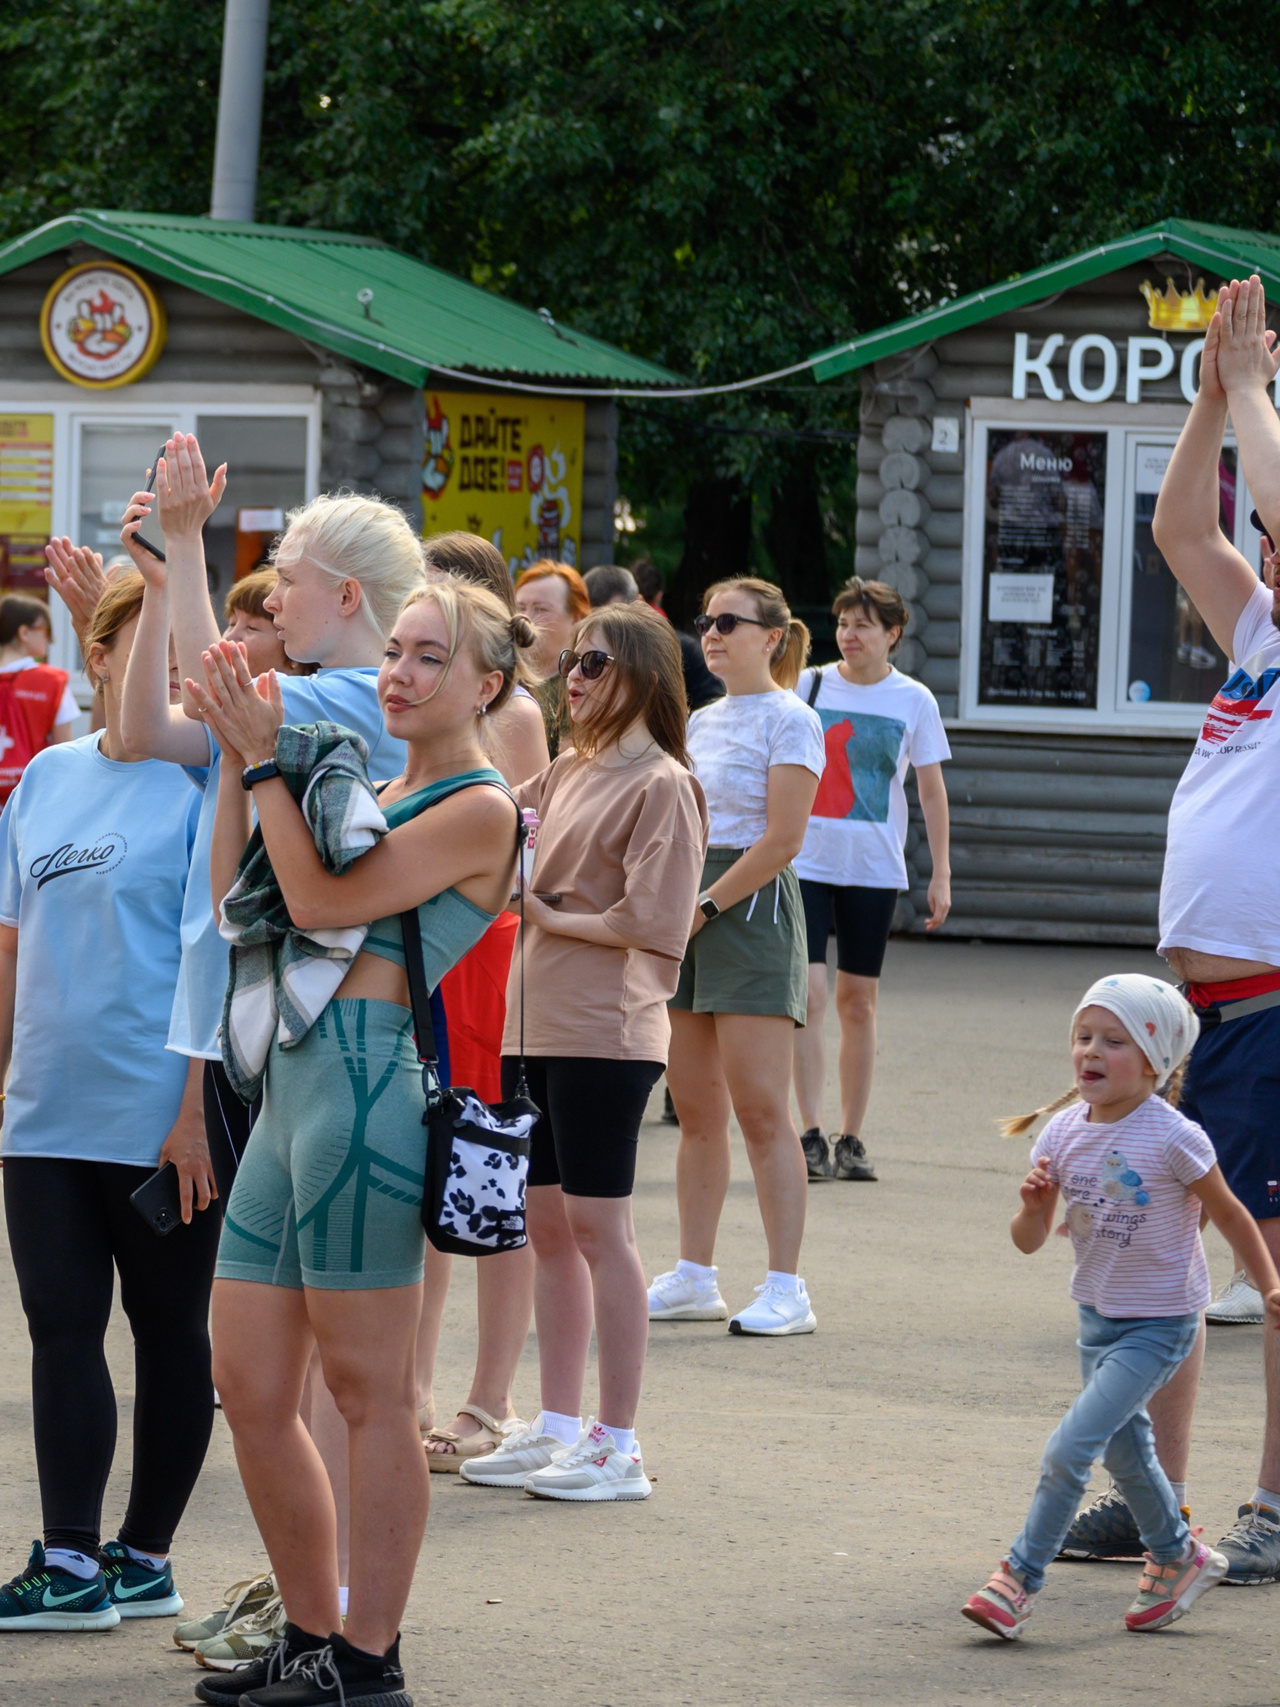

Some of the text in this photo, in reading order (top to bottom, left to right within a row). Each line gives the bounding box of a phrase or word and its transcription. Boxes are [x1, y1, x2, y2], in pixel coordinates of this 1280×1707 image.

[459, 407, 522, 454] ДАЙТЕ
[1020, 452, 1073, 472] Меню
[459, 456, 505, 492] ДВЕ!
[29, 842, 116, 880] Легко
[1071, 1173, 1098, 1187] one
[1102, 1211, 1147, 1232] wings
[1095, 1227, 1132, 1248] story
